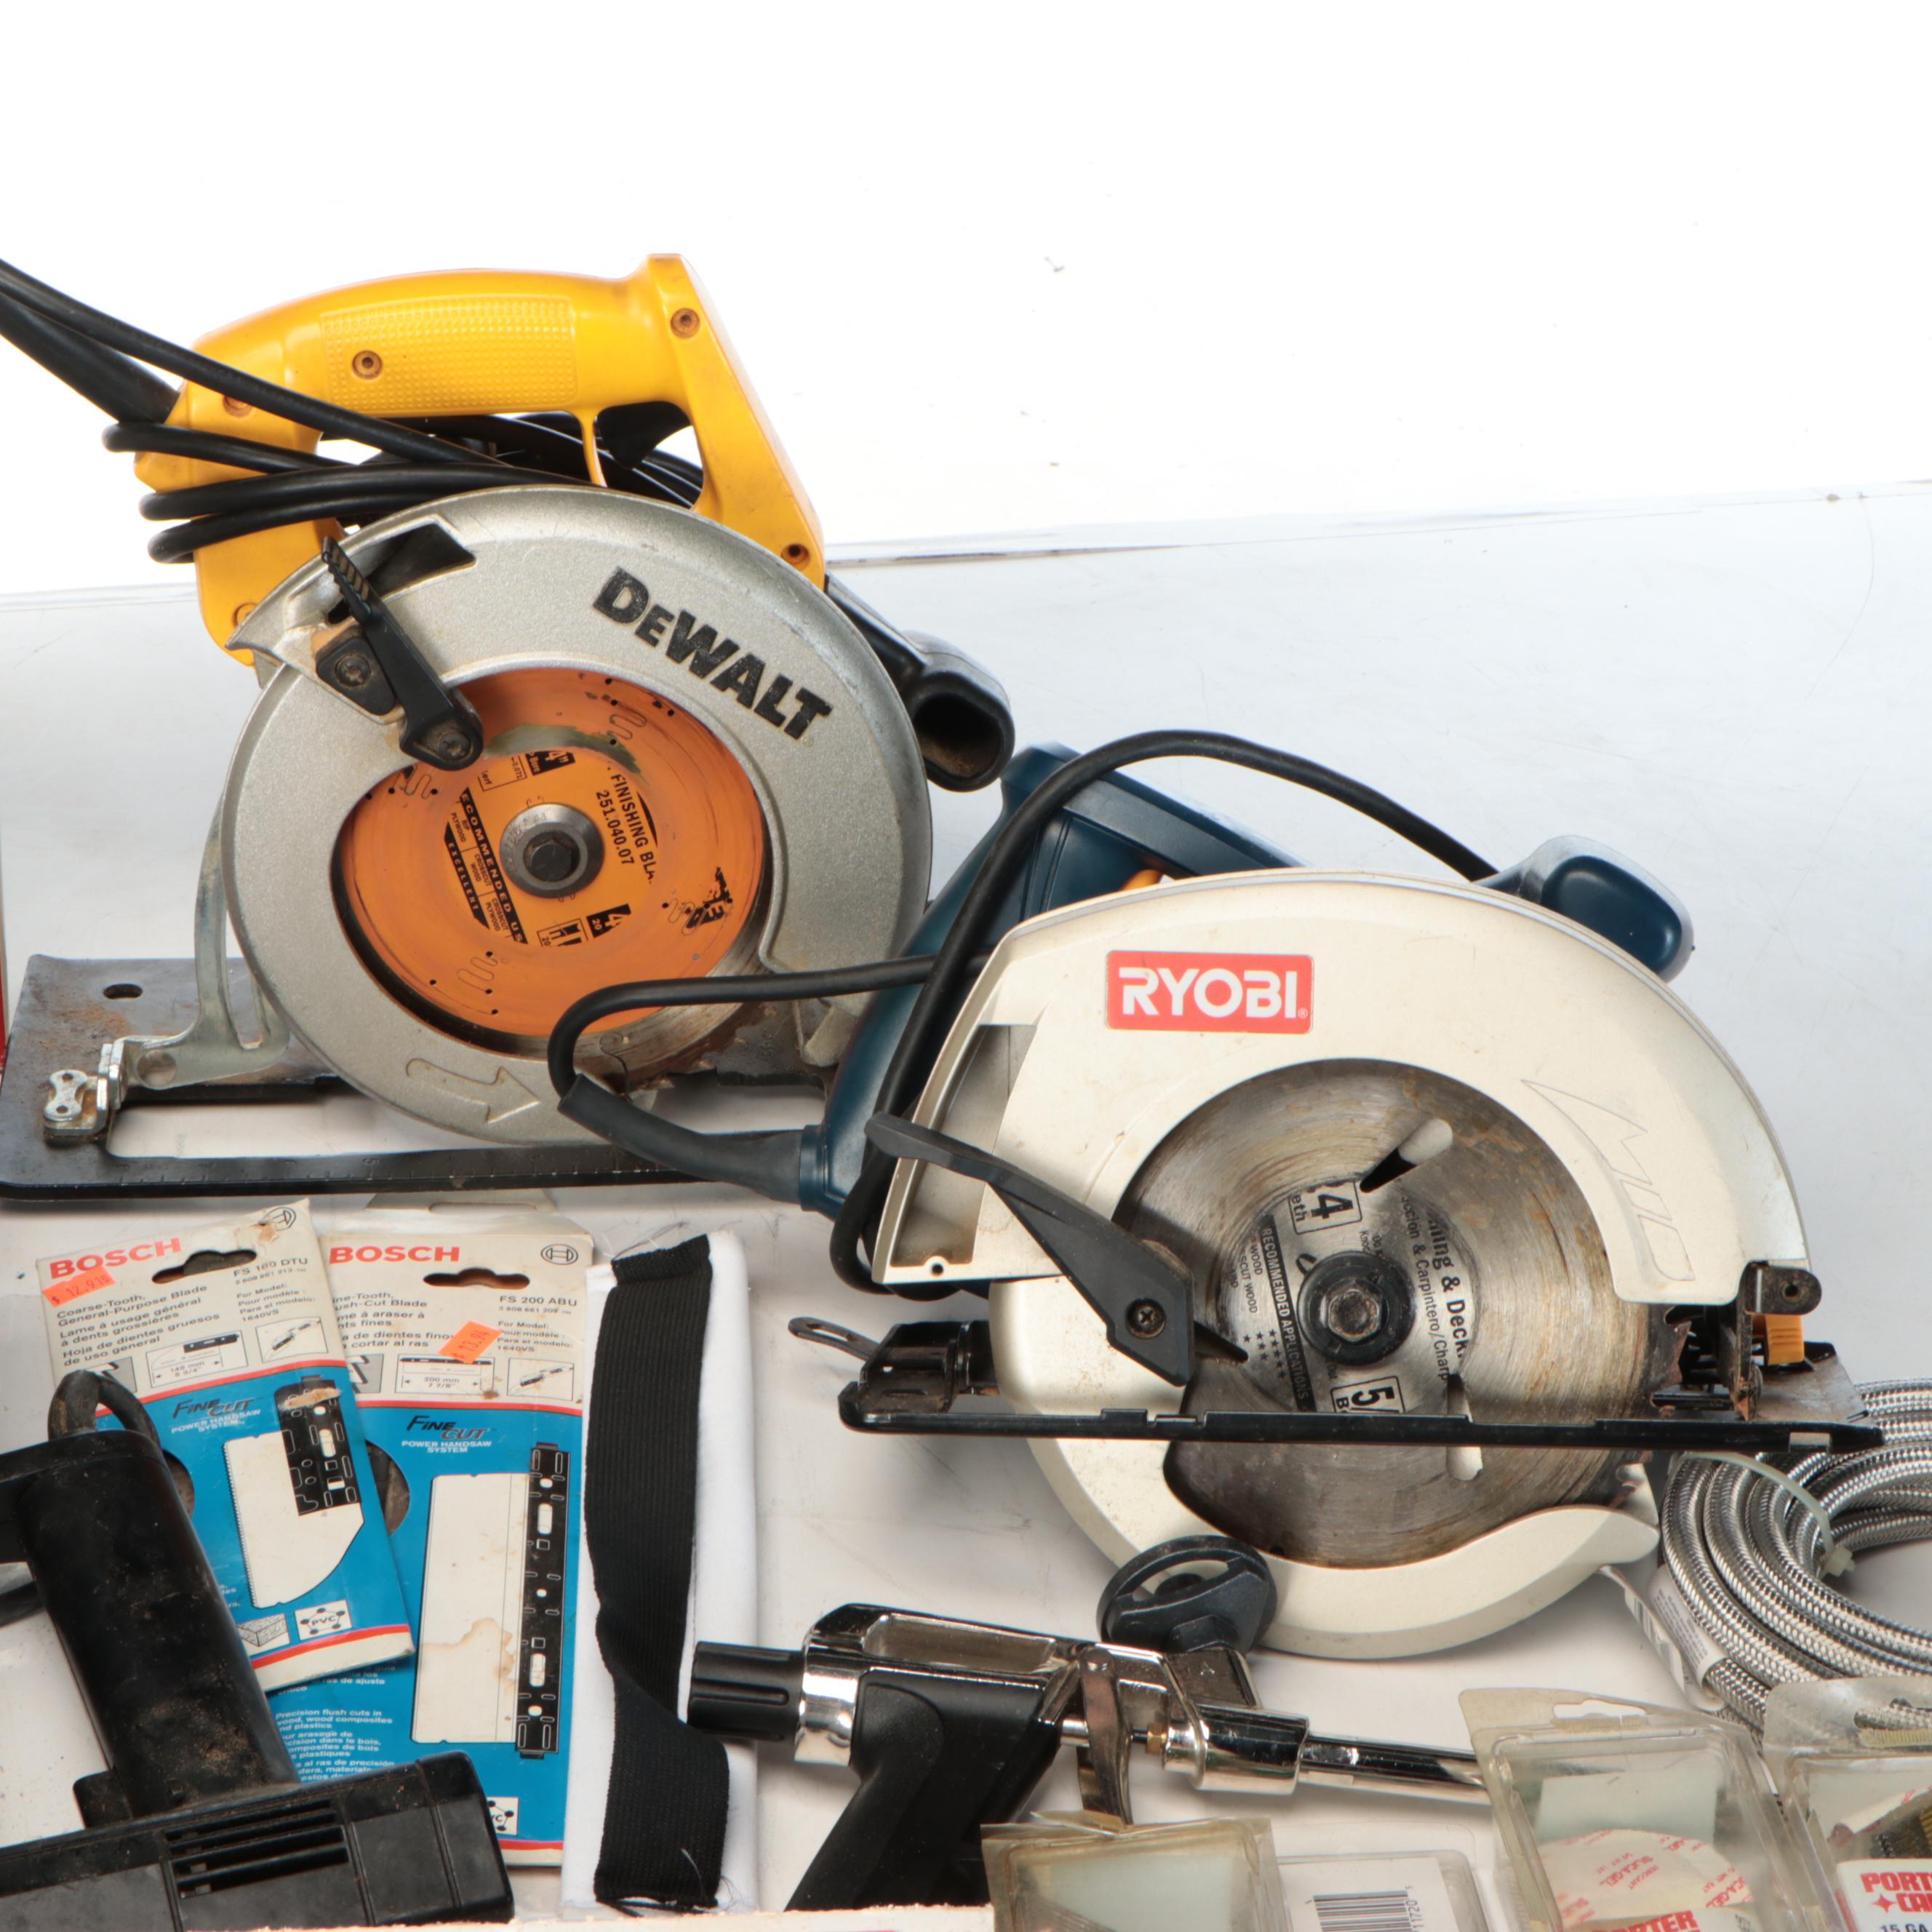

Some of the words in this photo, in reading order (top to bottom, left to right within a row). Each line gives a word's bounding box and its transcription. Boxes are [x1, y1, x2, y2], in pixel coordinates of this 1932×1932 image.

[611, 773, 649, 848] FINISHING
[596, 789, 635, 865] 251.040.07
[449, 842, 479, 910] EXCELLENT
[461, 792, 511, 913] ECOMMENDED
[511, 922, 523, 943] US
[470, 862, 482, 882] WOOD
[1119, 967, 1298, 1019] RYOBI
[1293, 1194, 1307, 1222] eth
[49, 1237, 181, 1280] BOSCH
[330, 1246, 460, 1264] BOSCH
[1250, 1245, 1263, 1275] WOOD
[1413, 1245, 1426, 1256] &
[233, 1267, 250, 1277] FS
[281, 1258, 308, 1266] DTU
[1240, 1255, 1251, 1280] SCUT
[1441, 1276, 1461, 1293] &
[58, 1296, 167, 1328] General-Purpose
[170, 1285, 207, 1300] Blade
[239, 1298, 260, 1306] Pour
[332, 1292, 394, 1304] ine-Tooth,
[335, 1300, 386, 1312] ush-Cut
[391, 1299, 428, 1308] Blade
[500, 1295, 516, 1303] FS
[548, 1298, 577, 1307] ABU
[1244, 1282, 1258, 1313] WOOD
[60, 1323, 95, 1339] Lame
[111, 1312, 150, 1327] usage
[153, 1297, 202, 1316] général
[240, 1306, 261, 1314] Para
[242, 1309, 279, 1322] 1640VS
[337, 1311, 356, 1321] me
[1262, 1228, 1290, 1318] RECOMMENDED
[1281, 1320, 1309, 1400] APPLICATIONS
[338, 1320, 356, 1329] nts
[1416, 1259, 1452, 1381] Carpintero/Charp
[1446, 1299, 1470, 1358] Deck
[63, 1346, 92, 1359] Hoja
[97, 1339, 113, 1350] de
[116, 1327, 164, 1345] dientes
[167, 1314, 220, 1332] gruesos
[73, 1330, 109, 1345] dents
[351, 1340, 389, 1349] cortar
[63, 1356, 80, 1367] de
[84, 1350, 108, 1362] uso
[112, 1336, 161, 1355] general
[188, 1360, 205, 1369] mm
[171, 1420, 208, 1434] POWER
[210, 1409, 261, 1424] HANDSAW
[442, 1428, 489, 1440] CUT
[311, 1616, 337, 1626] PVC
[276, 1709, 320, 1719] Precision
[285, 1738, 316, 1746] cision
[358, 1738, 381, 1746] bois,
[289, 1744, 340, 1752] omposites
[299, 1751, 351, 1759] plastiques
[1860, 1872, 1932, 1893] PORT
